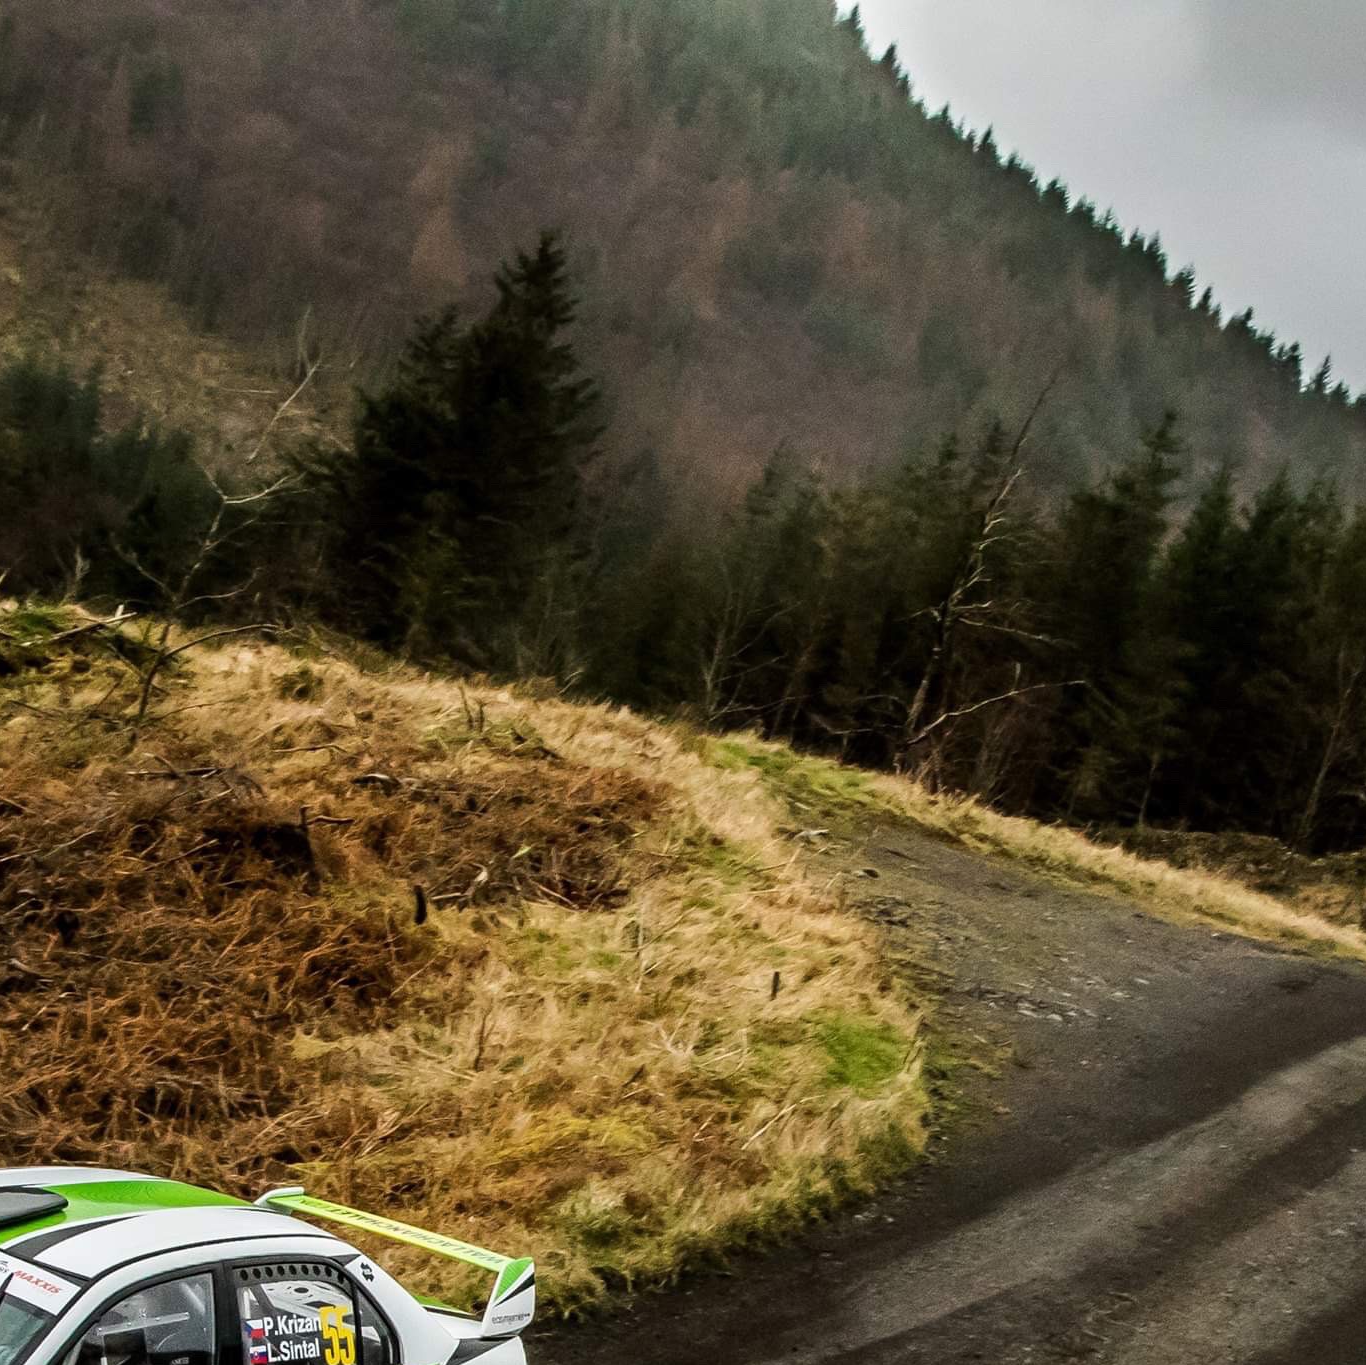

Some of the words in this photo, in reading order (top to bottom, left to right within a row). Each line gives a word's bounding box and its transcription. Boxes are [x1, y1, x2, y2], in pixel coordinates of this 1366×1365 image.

[13, 1269, 63, 1295] MAXXIS
[263, 1314, 322, 1337] P.Krizan
[267, 1338, 321, 1363] L.Sintal
